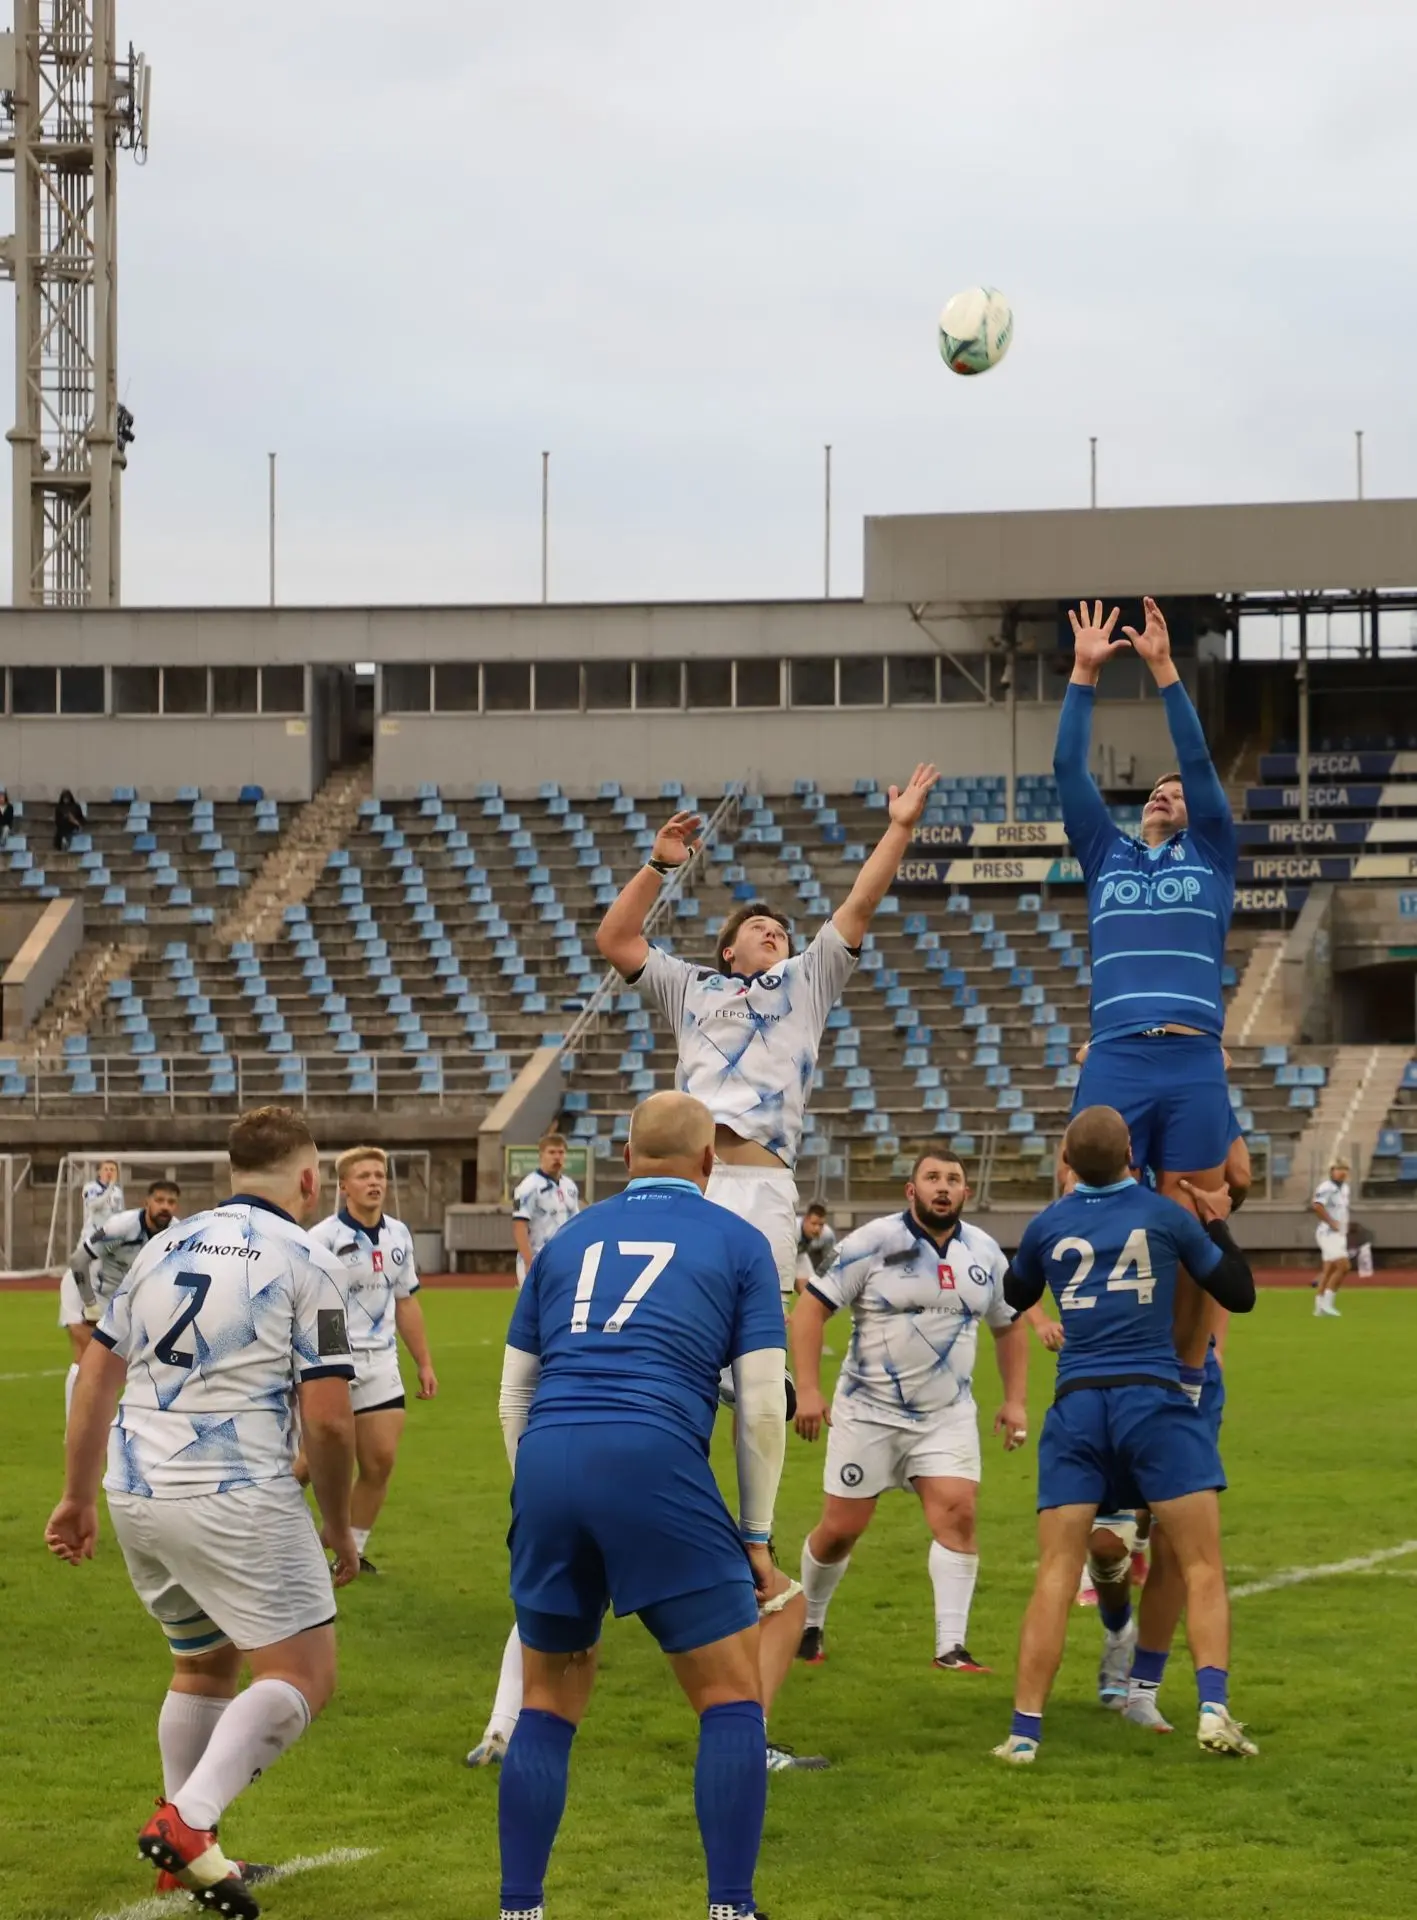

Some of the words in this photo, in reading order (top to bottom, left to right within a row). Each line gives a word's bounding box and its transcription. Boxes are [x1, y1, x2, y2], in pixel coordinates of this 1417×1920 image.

[911, 826, 962, 843] РЕССА
[996, 825, 1047, 842] PRESS
[1269, 824, 1336, 842] ПРЕССА
[897, 863, 938, 880] ЕССА
[973, 862, 1024, 878] PRESS
[1253, 859, 1322, 878] ПРЕССА
[1233, 889, 1288, 909] РЕССА
[188, 1240, 262, 1261] Имхотеп
[1051, 1228, 1157, 1310] 24
[571, 1240, 676, 1333] 17
[154, 1271, 212, 1369] 2
